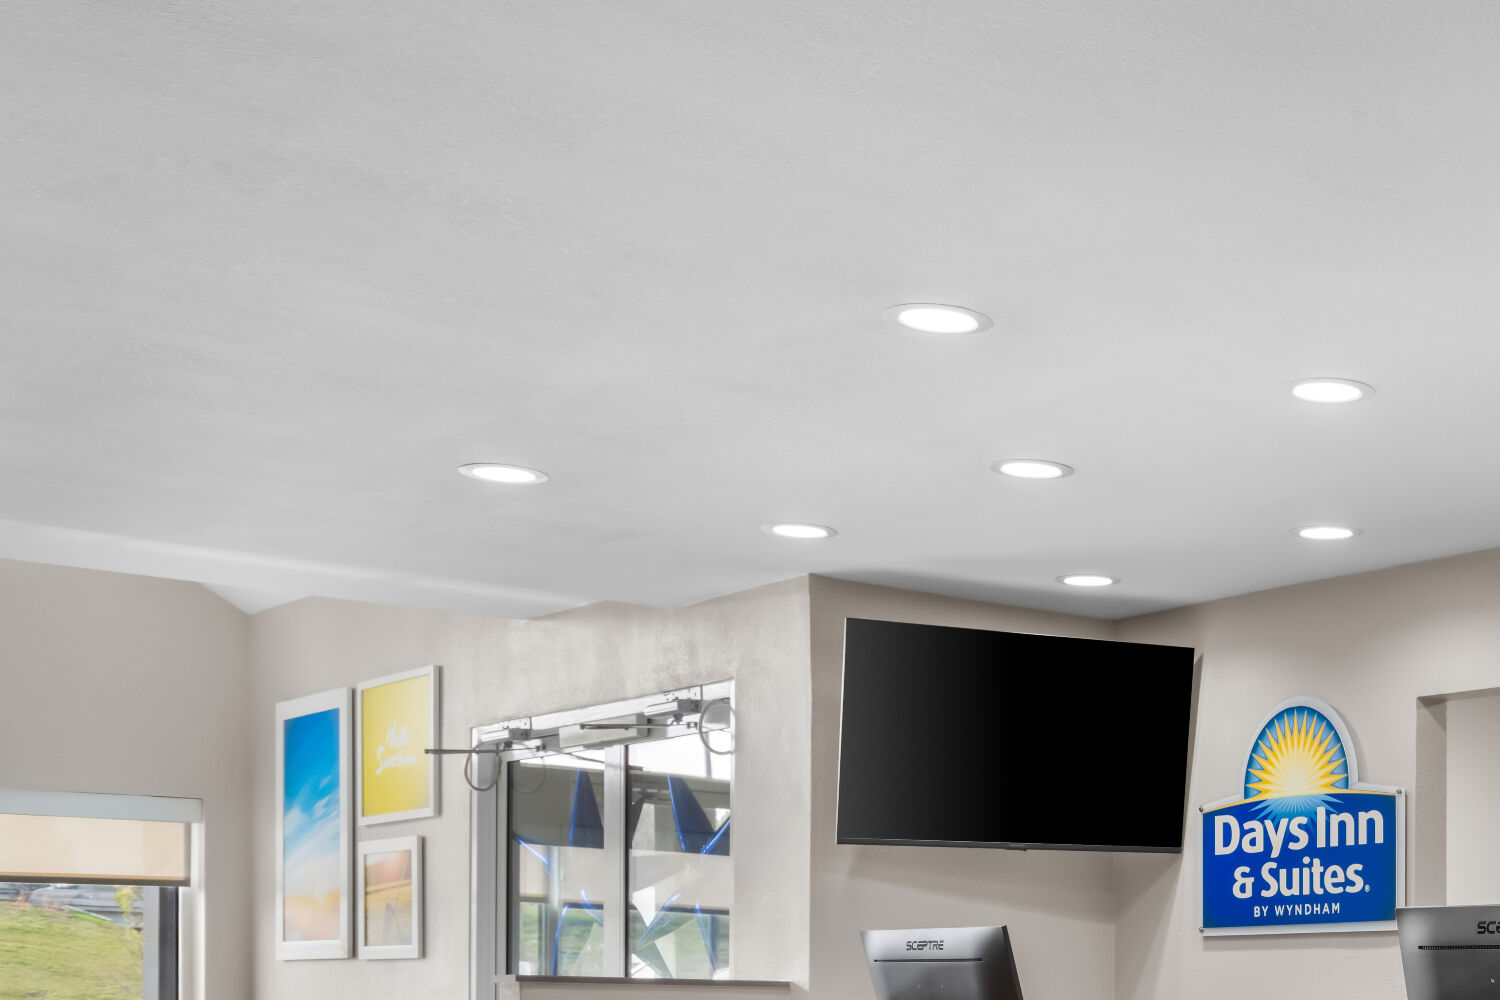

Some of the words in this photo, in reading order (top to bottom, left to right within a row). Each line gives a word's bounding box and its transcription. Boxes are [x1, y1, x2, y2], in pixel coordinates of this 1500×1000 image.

[1214, 814, 1309, 858] Days
[1316, 806, 1385, 849] Inn
[1232, 866, 1255, 899] &
[1253, 906, 1269, 918] BY
[1274, 902, 1341, 917] WYNDHAM
[906, 940, 944, 951] SCEPTRE
